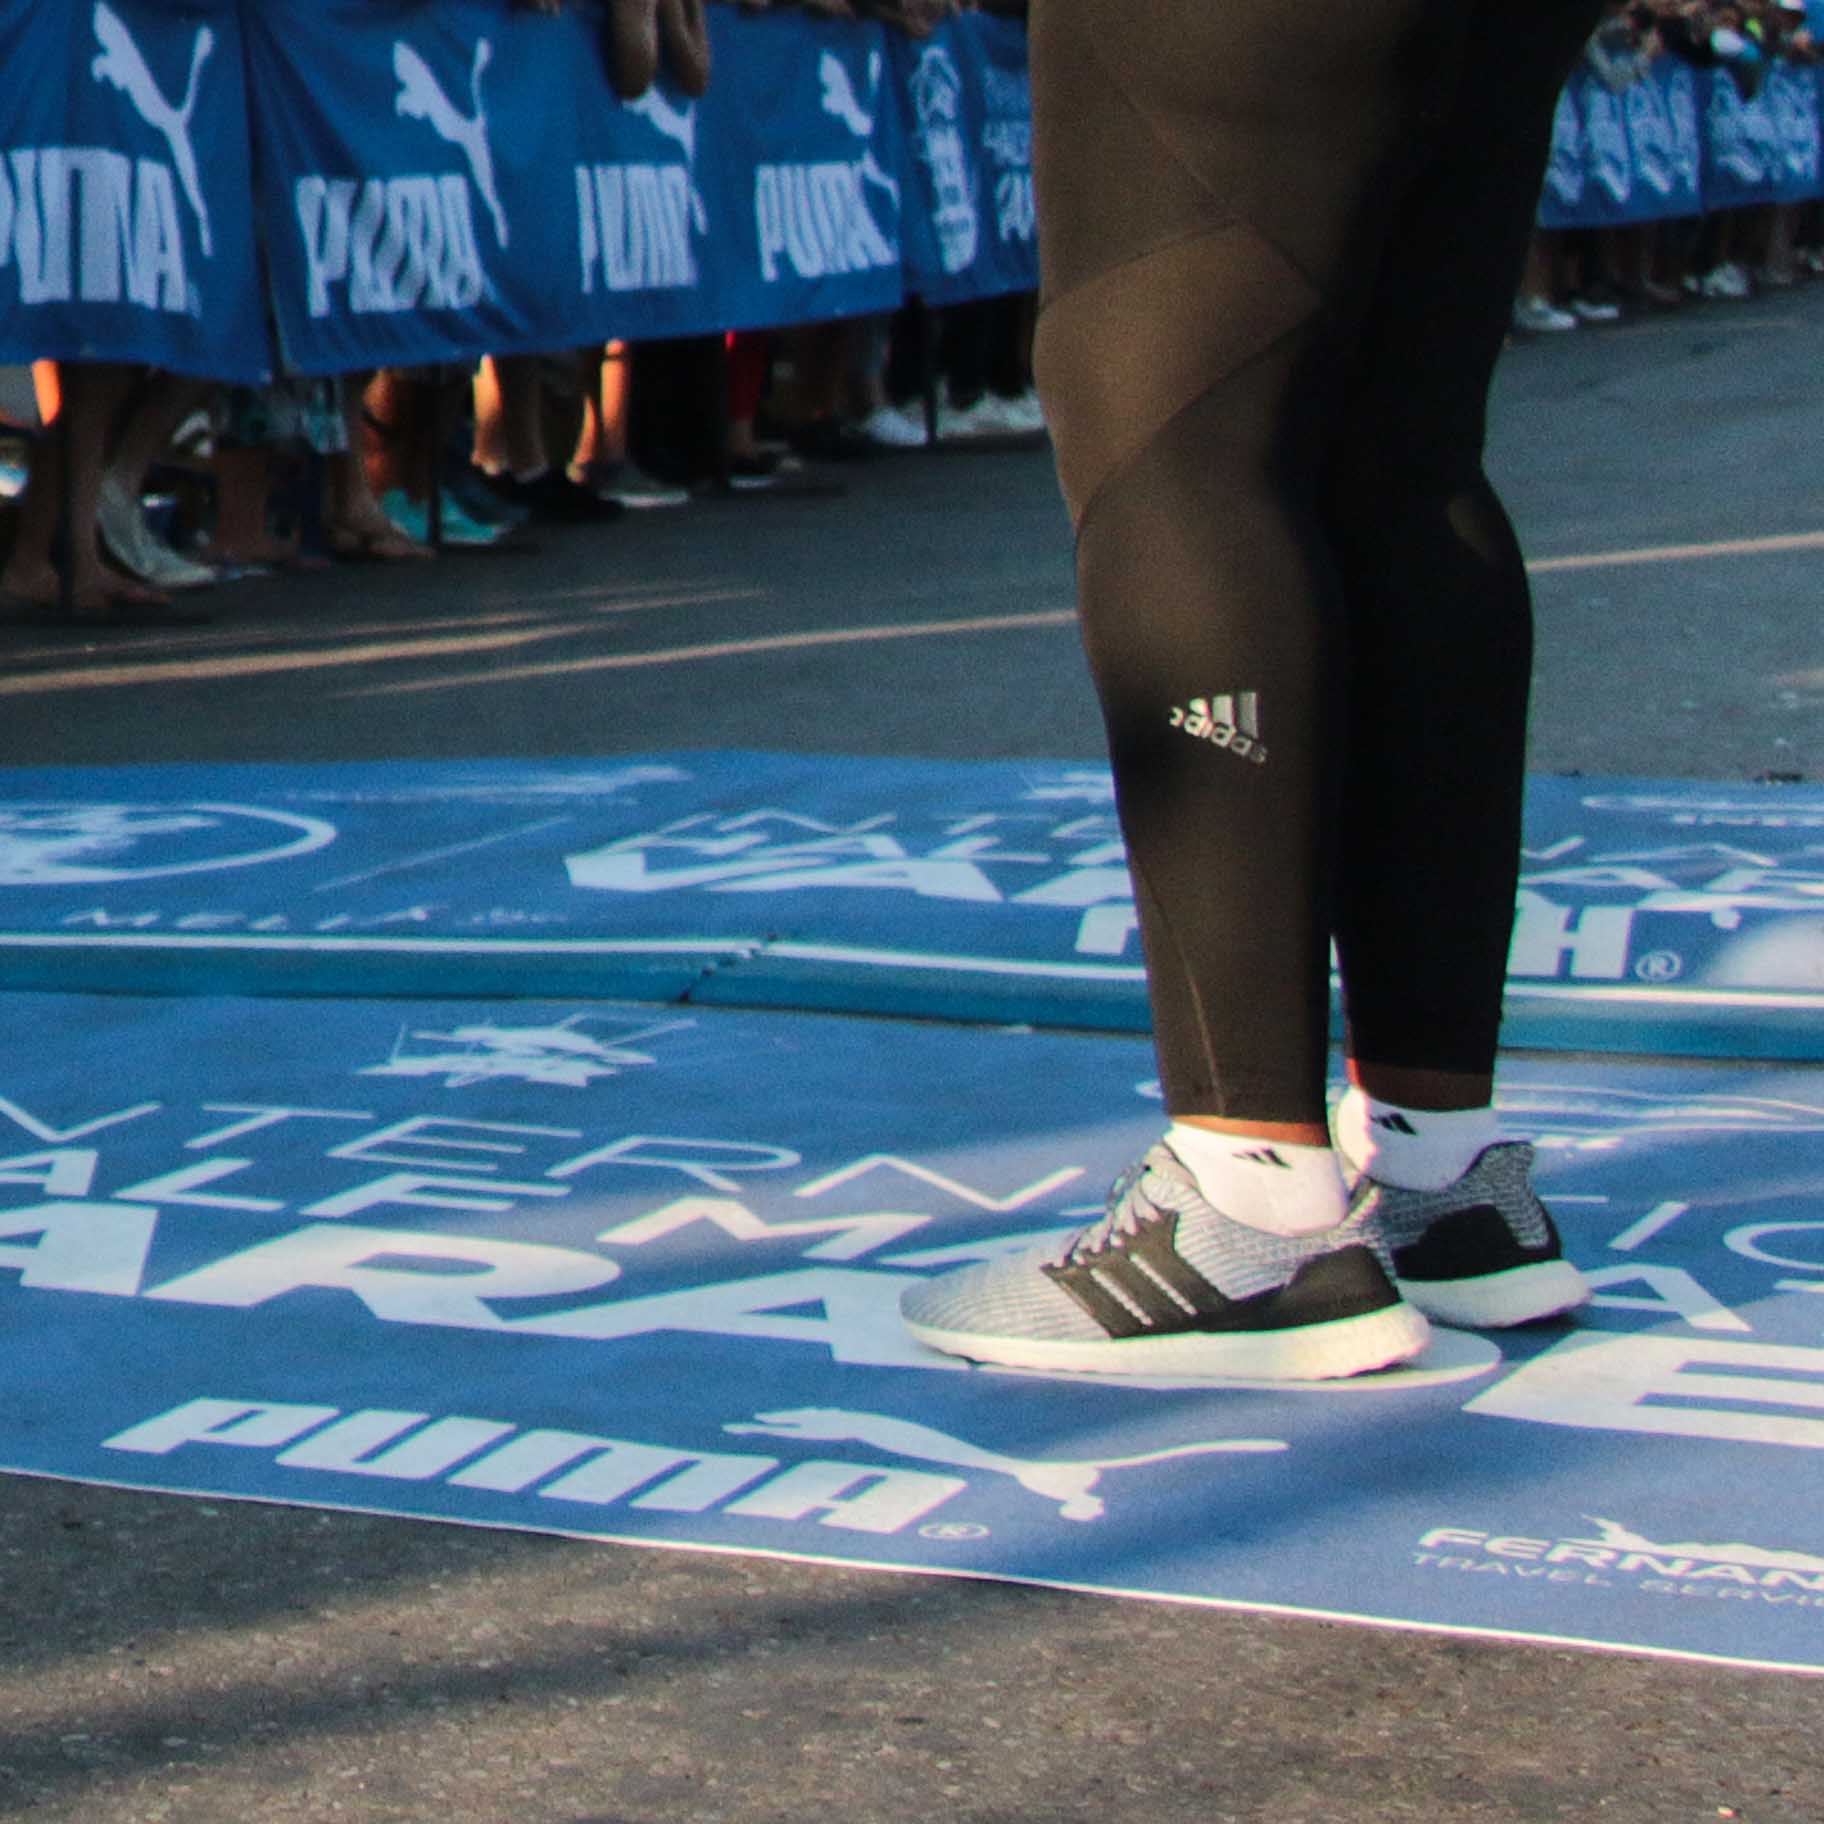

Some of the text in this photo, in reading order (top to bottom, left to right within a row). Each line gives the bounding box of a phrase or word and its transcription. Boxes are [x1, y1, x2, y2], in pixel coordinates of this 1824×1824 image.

[1169, 706, 1268, 764] adidas
[102, 1396, 968, 1535] PUMA
[1414, 1551, 1612, 1587] TRAVEL
